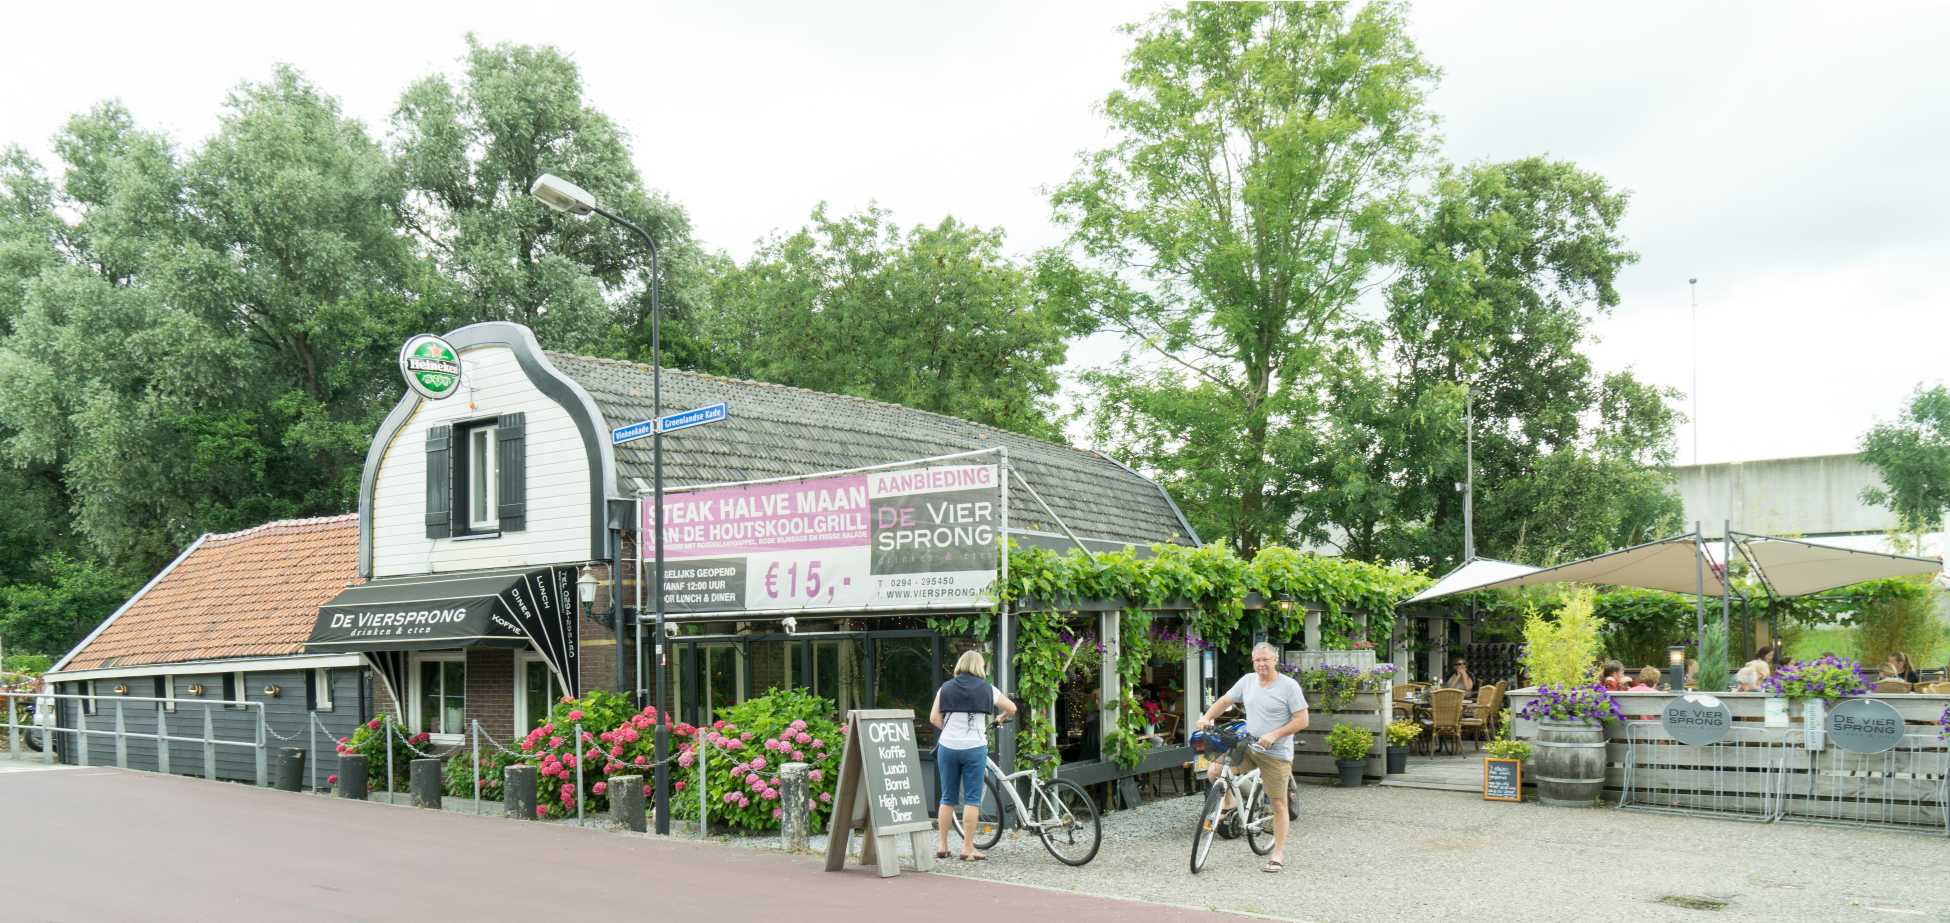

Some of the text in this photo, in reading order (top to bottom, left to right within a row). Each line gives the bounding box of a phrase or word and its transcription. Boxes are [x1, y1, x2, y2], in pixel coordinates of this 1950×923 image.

[409, 359, 459, 375] Heineken
[664, 408, 721, 428] Groenlandse Kade
[877, 466, 990, 494] AANBIEDING
[719, 493, 790, 520] HALVE
[796, 485, 866, 516] MAAN
[878, 502, 993, 528] DE VIER
[684, 525, 705, 542] DE
[709, 513, 867, 541] HOUTSKOOLGRILL
[878, 525, 994, 551] SPRONG
[697, 567, 736, 578] GEOPEND
[687, 580, 708, 591] 12:00
[709, 580, 726, 590] UUR
[890, 578, 912, 588] 0294
[921, 576, 954, 587] 295450
[537, 575, 551, 609] LUNCH
[676, 593, 702, 604] LUNCH
[703, 594, 710, 603] &
[711, 592, 736, 602] DINER
[511, 588, 531, 619] DINER
[330, 608, 466, 628] DE VIERSPRONG
[492, 614, 521, 635] KOFFIE
[350, 626, 431, 637] drinken & eten
[1668, 709, 1722, 719] DE VIER
[1668, 717, 1723, 726] SPRONG
[1833, 714, 1896, 727] DE VIER
[868, 722, 911, 743] OPEN!
[1833, 723, 1897, 735] SPRONG
[878, 746, 906, 760] Koffie
[882, 762, 907, 776] Lunch
[884, 777, 910, 792] Borrel
[878, 792, 920, 811] High wine
[891, 810, 913, 823] Diner
